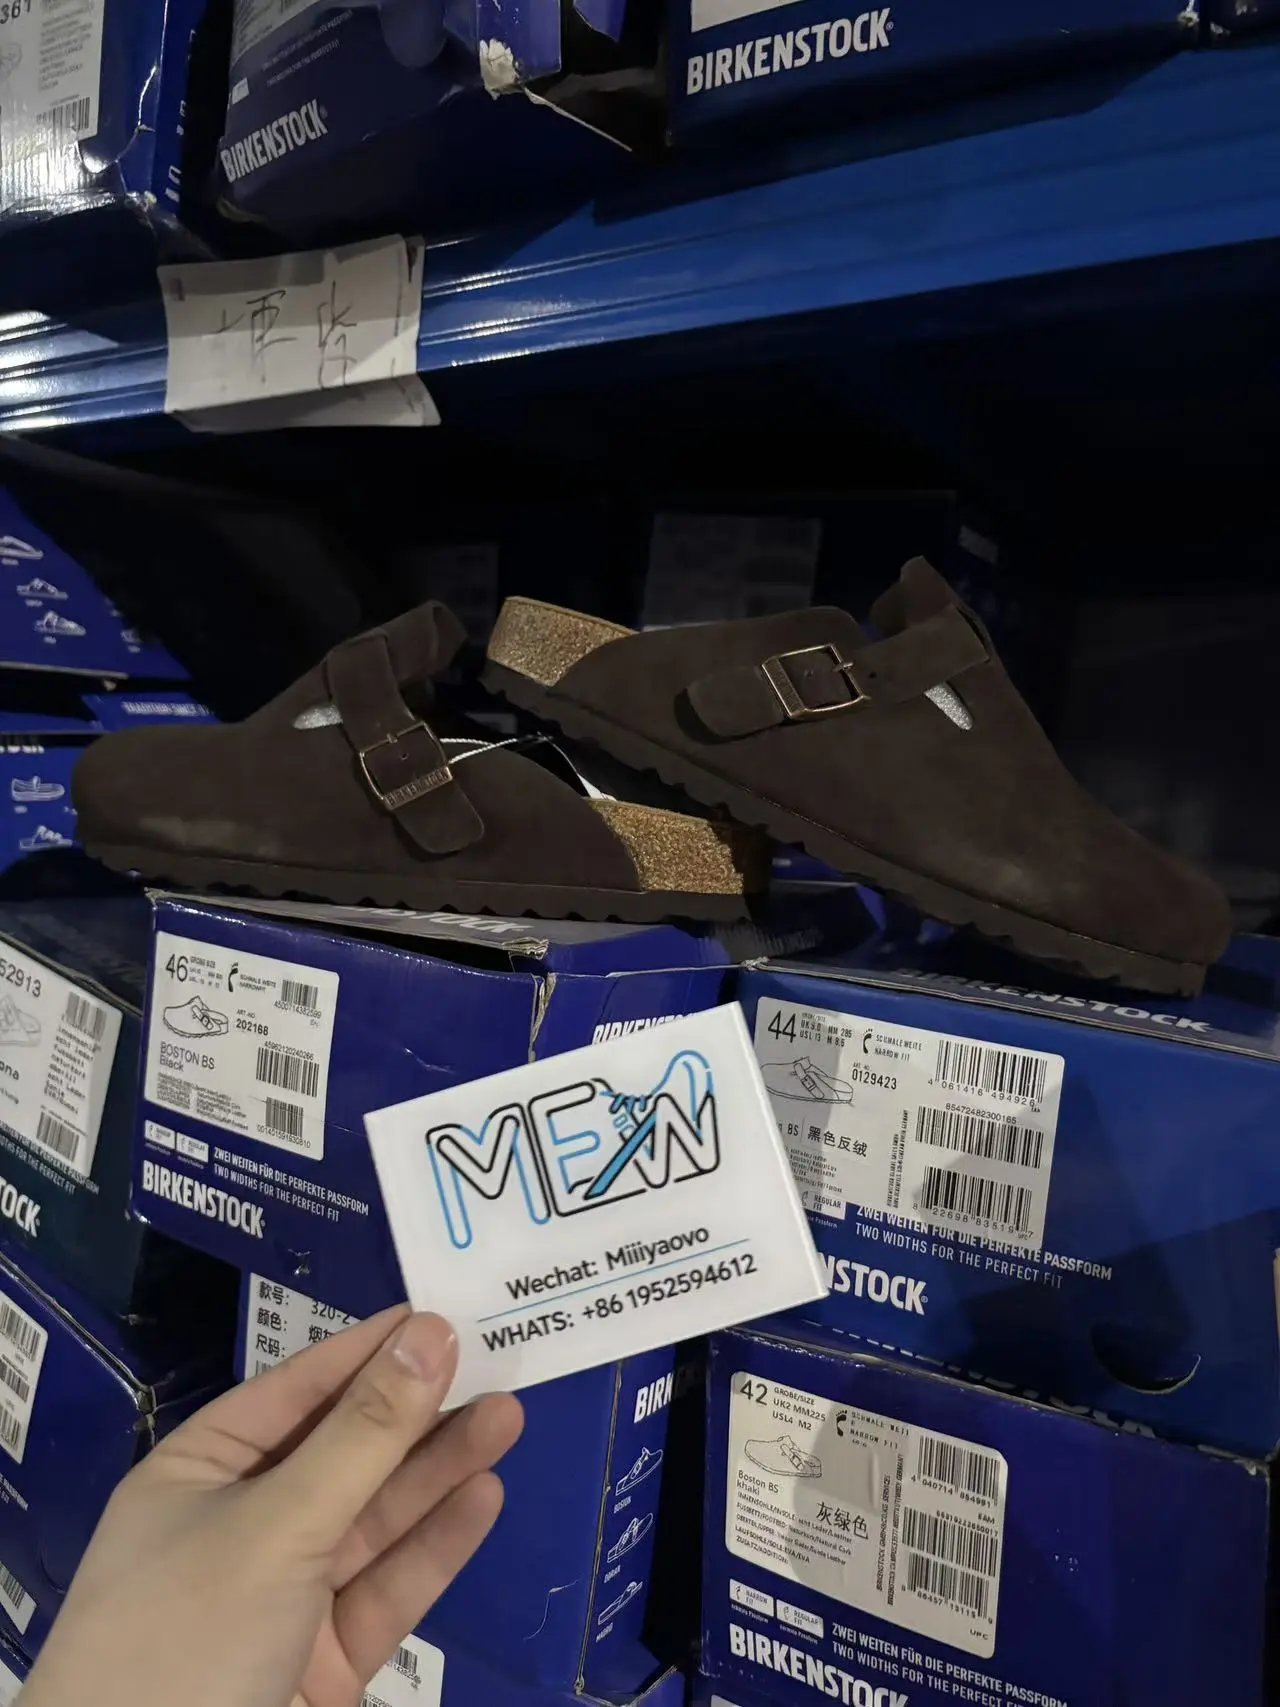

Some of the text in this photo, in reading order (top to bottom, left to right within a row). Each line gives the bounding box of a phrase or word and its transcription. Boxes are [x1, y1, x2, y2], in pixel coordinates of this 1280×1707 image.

[686, 7, 891, 95] BIRKENSTOCK
[220, 99, 328, 183] BIRKENSTOCK
[165, 953, 189, 982] 46
[768, 1010, 797, 1043] 44
[159, 1054, 185, 1072] Black
[160, 1041, 215, 1070] BOSTON BS
[852, 1068, 897, 1090] 0129423
[942, 1081, 984, 1097] 061416
[991, 1091, 1035, 1108] 494926
[807, 1125, 868, 1157] 黑色反绒
[213, 1163, 340, 1223] TWO WIDTHS FOR THE PERFECT FIT
[214, 1146, 231, 1162] ZWEI
[231, 1152, 258, 1174] WEITEN
[259, 1162, 274, 1179] FÜR
[274, 1170, 288, 1185] DIE
[288, 1175, 326, 1199] PERFEKTE
[327, 1188, 369, 1216] PASSFORM
[142, 1159, 264, 1239] BIRKENSTOCK
[814, 1194, 841, 1208] REGULAR
[932, 1207, 969, 1223] 22698
[506, 1227, 709, 1300] Wechat: Miiiyaovo
[856, 1222, 1063, 1289] TWO WIDTHS FOR THE PERFECT FIT
[958, 1231, 977, 1248] DIE
[980, 1236, 1041, 1263] PERFEKTE
[1043, 1252, 1112, 1281] PASSFORM
[481, 1253, 758, 1352] WHATS: +86 1952594612
[256, 1333, 286, 1358] 尺码:
[740, 1380, 768, 1406] 42
[772, 1410, 812, 1431] USL4 M2
[773, 1398, 826, 1422] UK2 MM225
[736, 1479, 760, 1496] khaki
[738, 1470, 779, 1494] Boston BS
[922, 1478, 953, 1495] 040714
[816, 1501, 869, 1540] 灰绿色
[832, 1622, 857, 1642] ZWEI
[859, 1632, 899, 1659] WEITEN
[901, 1646, 923, 1667] FÜR
[926, 1655, 944, 1673] DIE
[947, 1664, 1003, 1693] PERFEKTE
[832, 1640, 1002, 1707] TWO WIDTHS FOR THE PERFECT
